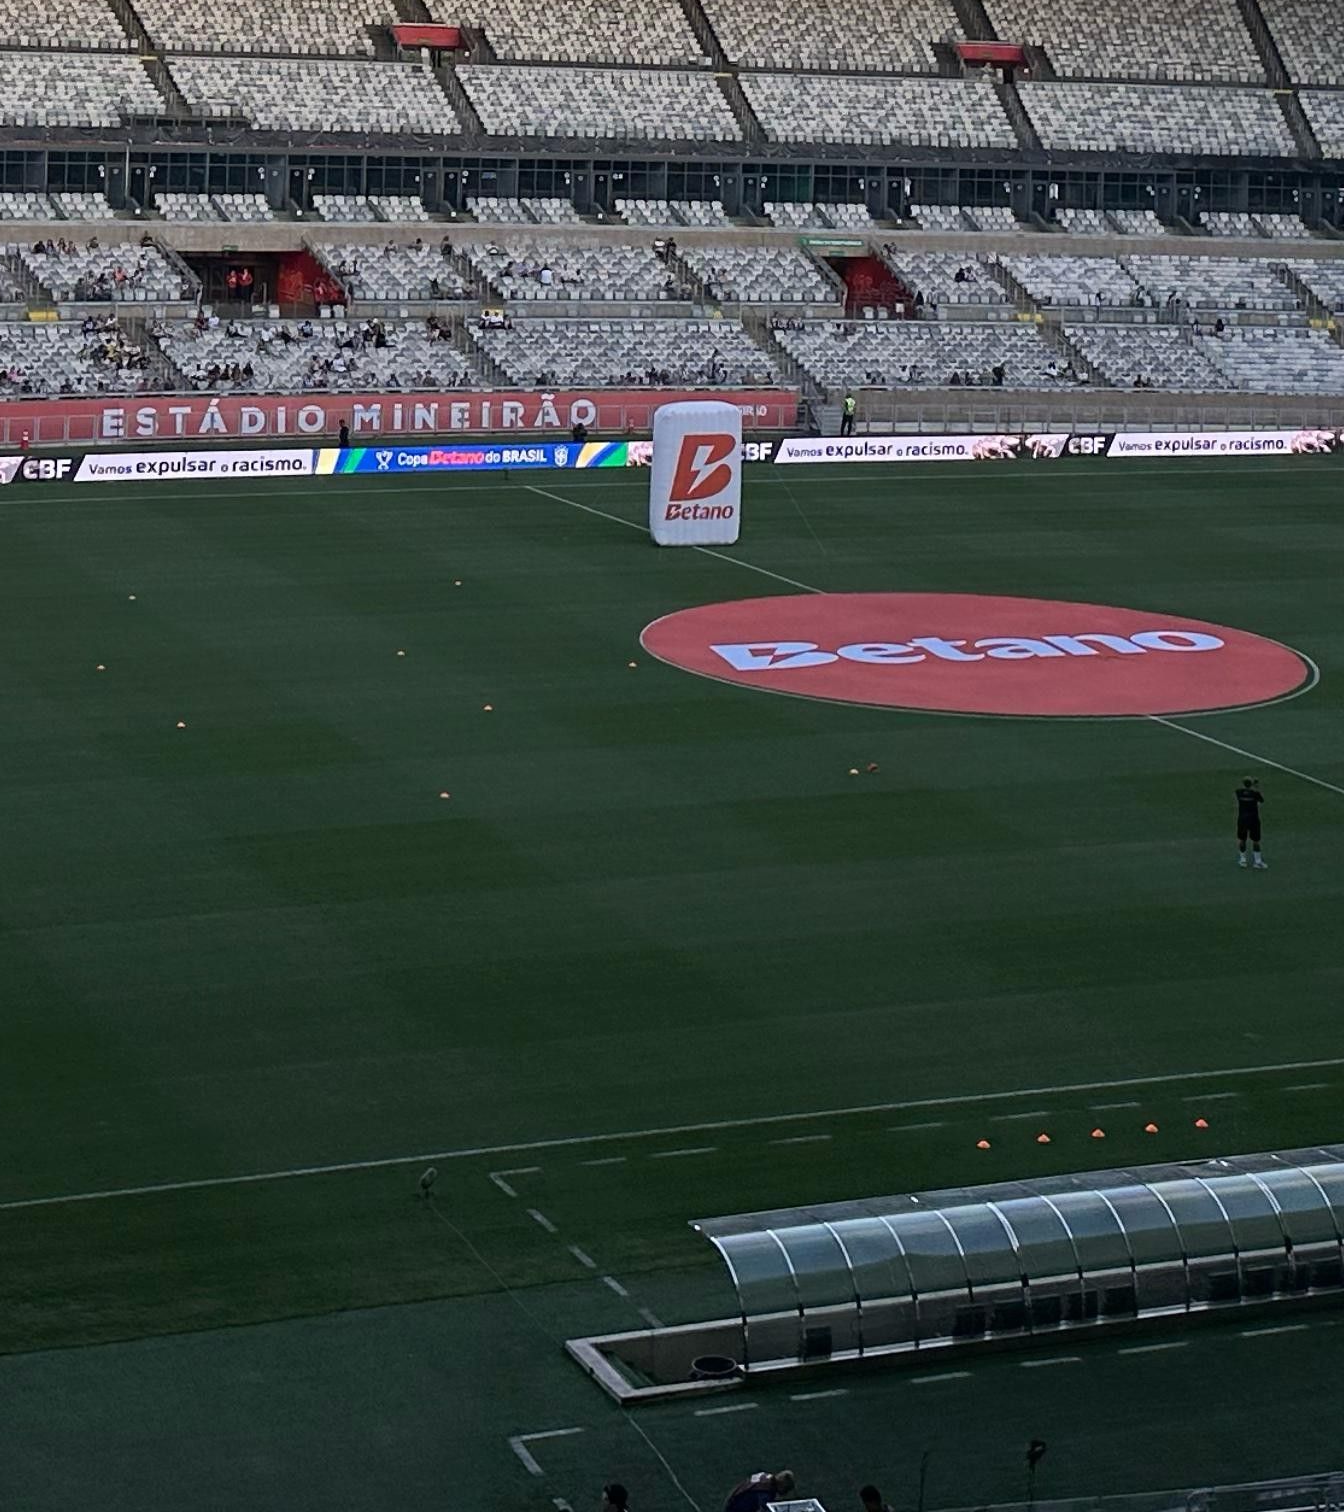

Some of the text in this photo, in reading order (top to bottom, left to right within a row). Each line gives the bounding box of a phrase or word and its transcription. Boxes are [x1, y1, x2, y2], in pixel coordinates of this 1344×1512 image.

[102, 394, 597, 436] ESTÁDIO MINEIRÃO
[742, 442, 773, 462] BF
[826, 443, 893, 459] expulsar
[905, 443, 968, 456] racismo.
[1068, 438, 1105, 454] CBF
[1155, 437, 1217, 453] expulsar
[1229, 437, 1286, 450] racismo.
[89, 464, 132, 475] Vamos
[136, 458, 216, 476] expulsar
[233, 457, 307, 471] racismo.
[398, 452, 428, 467] Copa
[486, 450, 500, 462] do
[502, 449, 547, 462] BRASIL
[23, 460, 71, 479] CBF
[665, 504, 733, 521] Betano
[709, 629, 1226, 671] Betano
